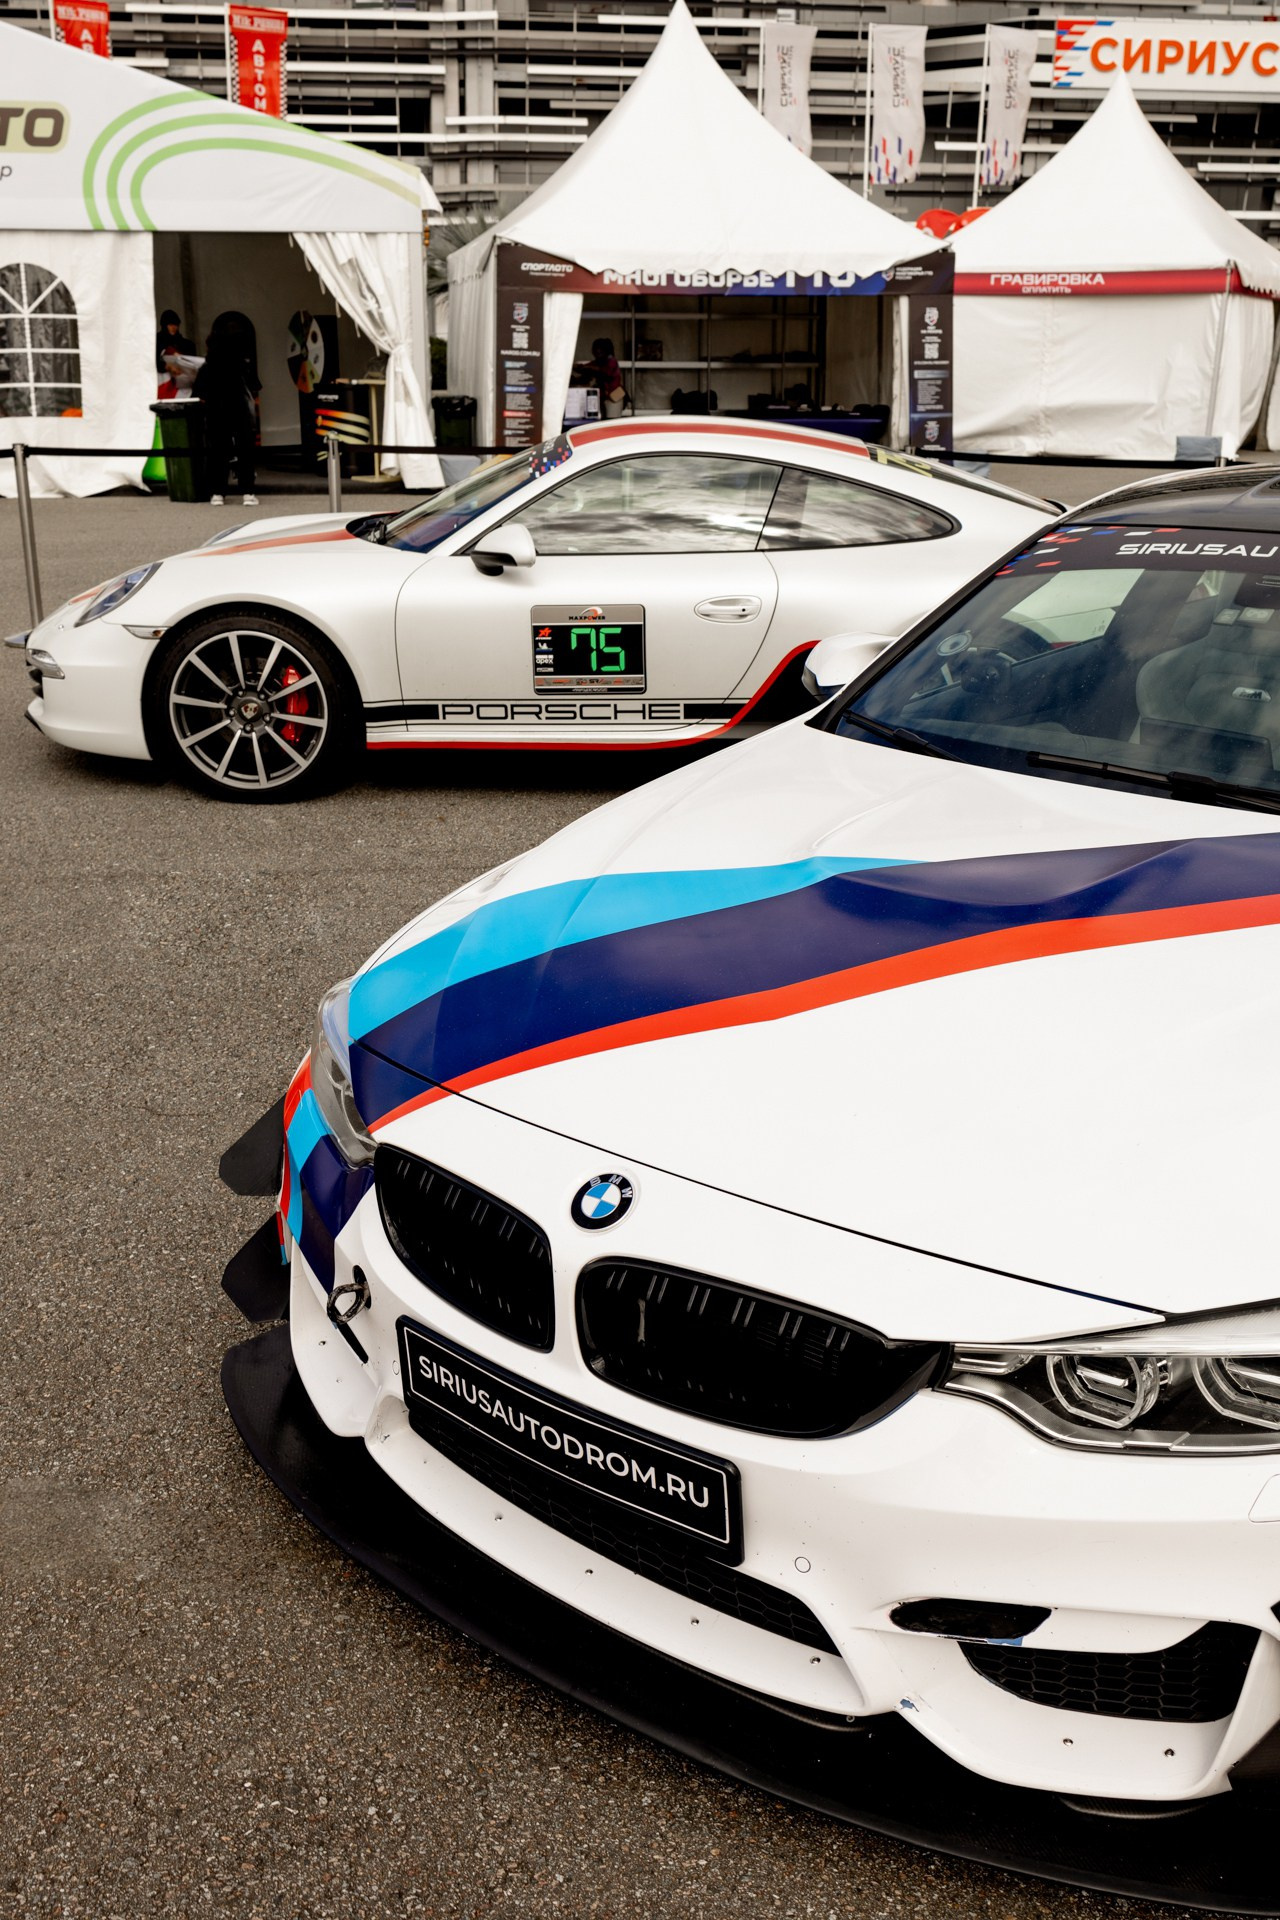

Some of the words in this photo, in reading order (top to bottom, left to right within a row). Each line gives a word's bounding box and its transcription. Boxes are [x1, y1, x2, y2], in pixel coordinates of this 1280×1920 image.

[1090, 37, 1280, 77] СИРИУС
[520, 262, 574, 273] СПОРТЛОТО
[990, 273, 1105, 286] ГРАВИРОВКА
[1116, 543, 1279, 558] SIRIUSAU
[571, 627, 625, 672] 75
[441, 703, 681, 720] PORSCHE
[589, 1173, 633, 1198] BMW
[418, 1355, 710, 1508] SIRIUSAUTODROM.RU
